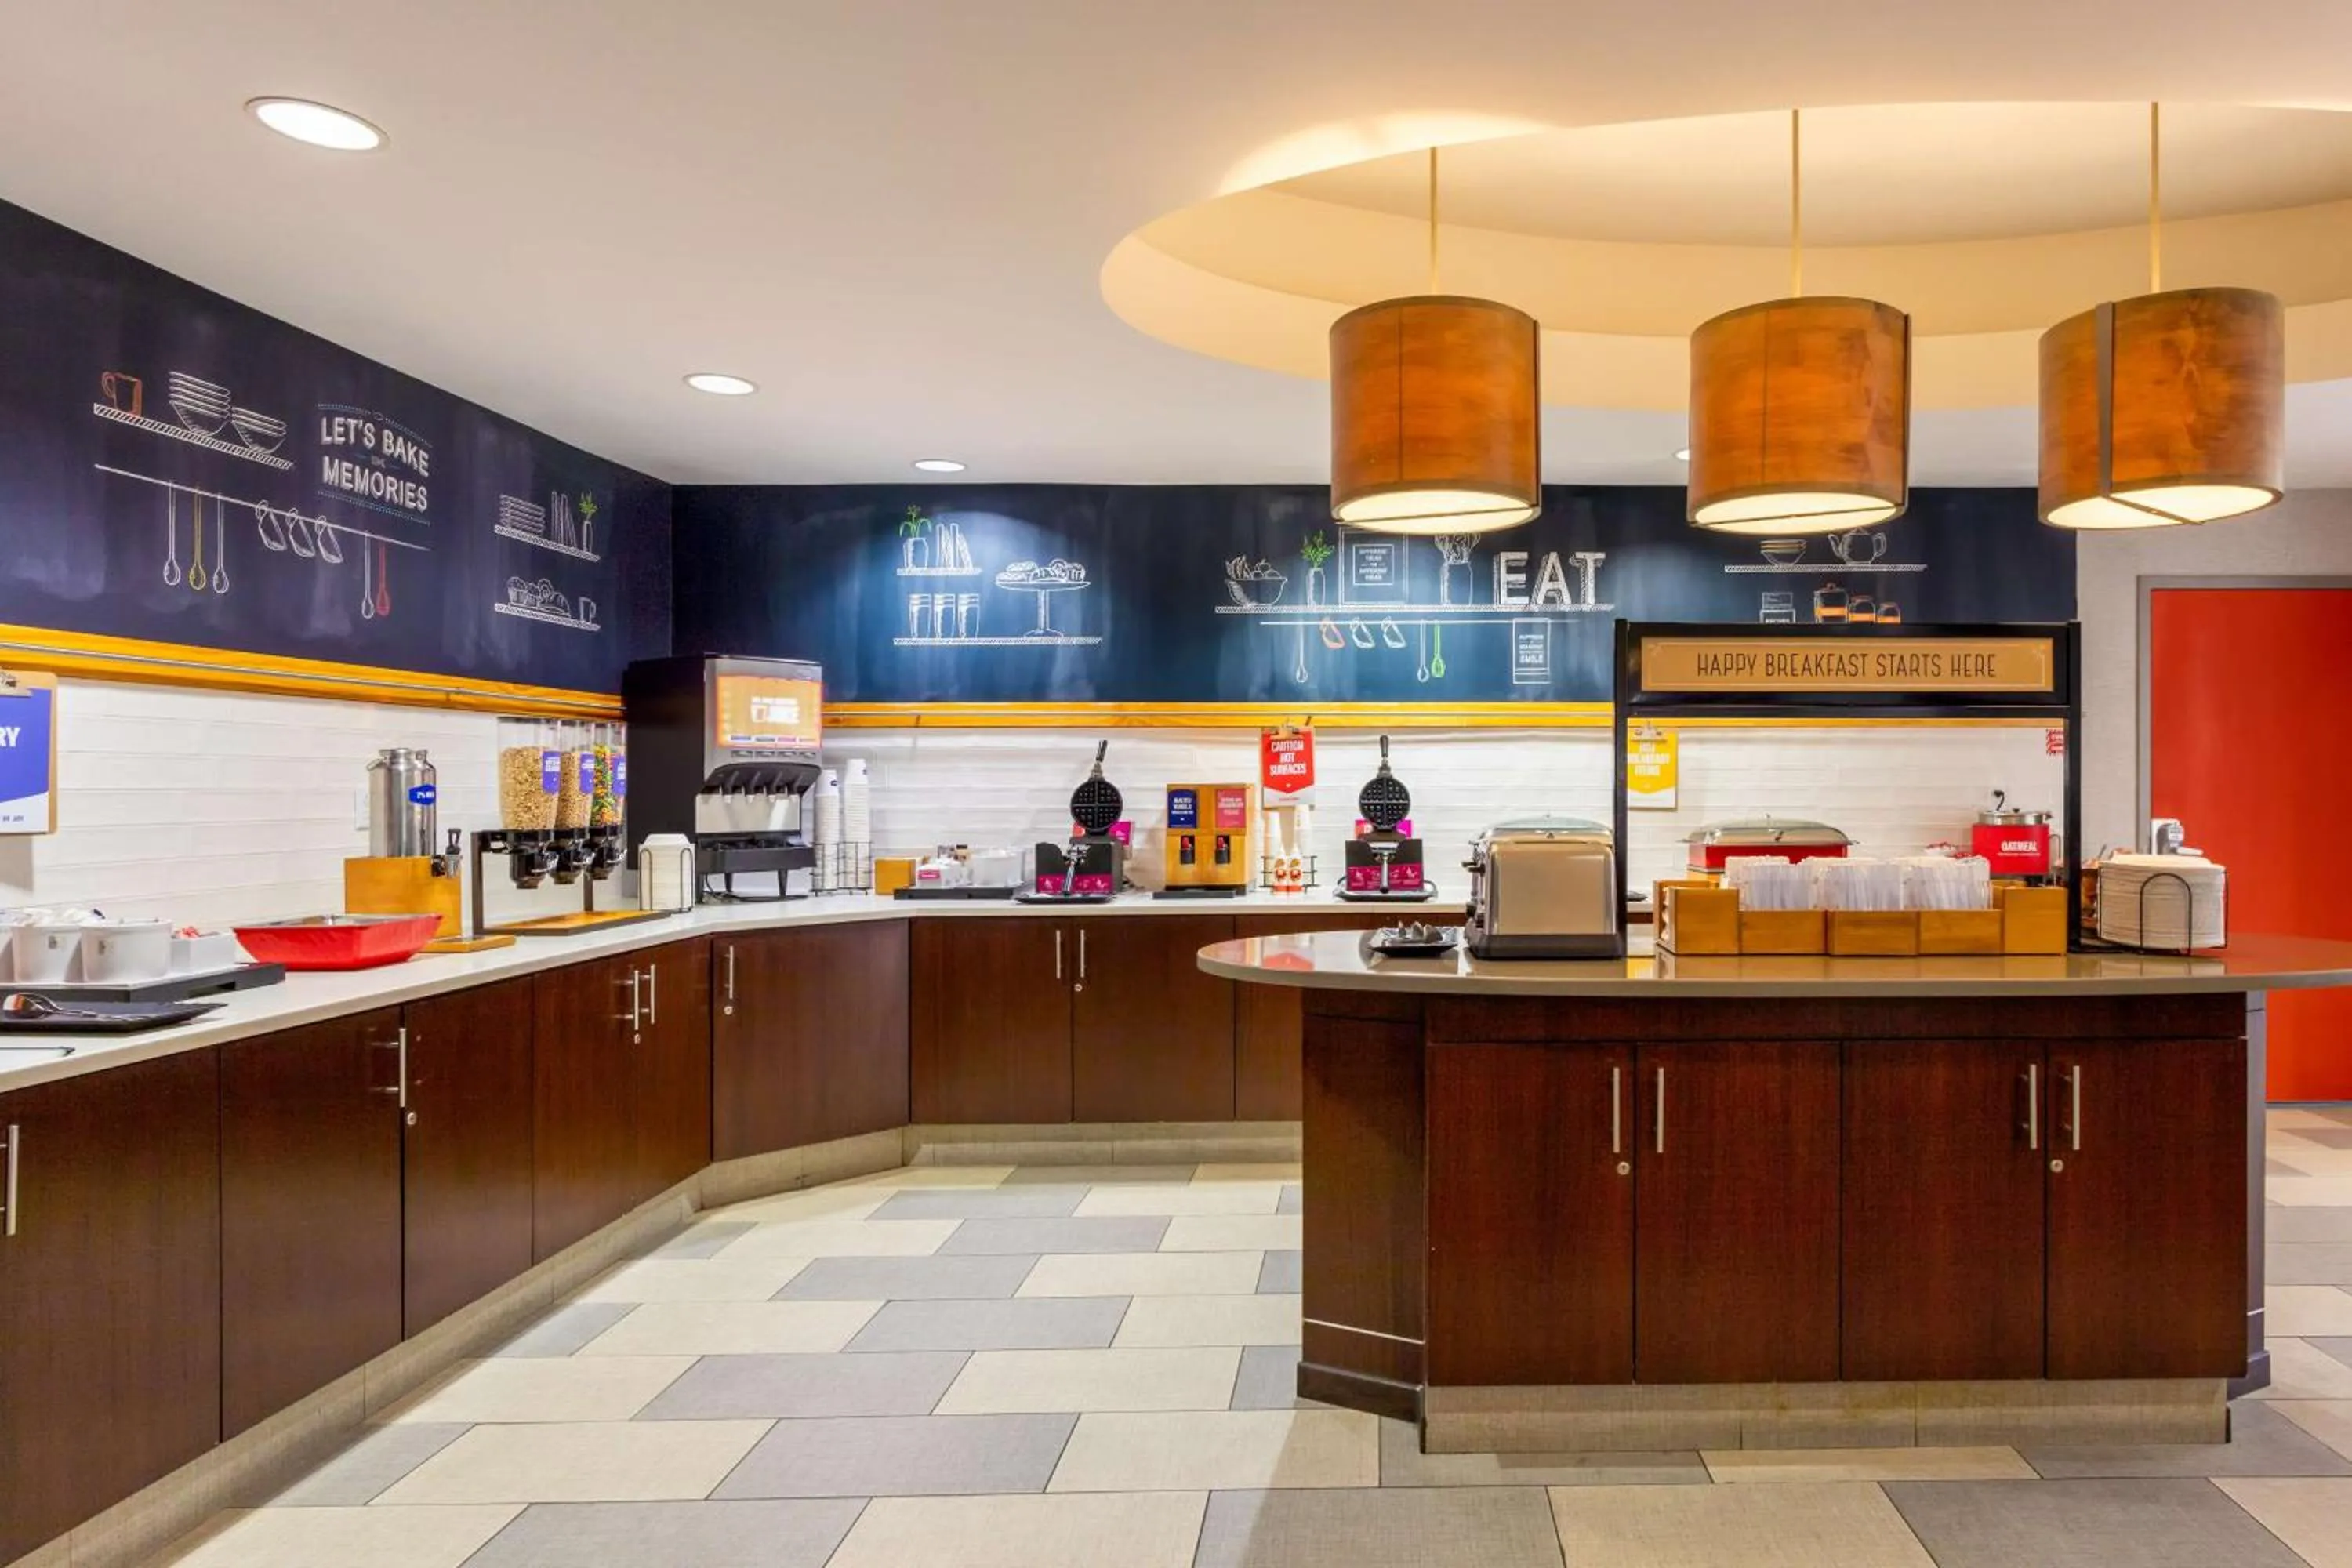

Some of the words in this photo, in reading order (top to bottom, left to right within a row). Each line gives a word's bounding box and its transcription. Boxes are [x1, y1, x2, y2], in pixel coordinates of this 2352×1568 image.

[321, 416, 376, 449] LET'S
[382, 429, 430, 478] BAKE
[322, 455, 428, 514] MEMORIES
[1493, 551, 1606, 606] EAT
[1697, 652, 1758, 677] HAPPY
[1765, 652, 1869, 677] BREAKFAST
[1875, 652, 1943, 678] STARTS
[1951, 653, 1998, 678] HERE
[1271, 739, 1305, 753] CAUTION
[1279, 752, 1296, 764] HOT
[1269, 763, 1308, 776] SURFACES
[2001, 840, 2038, 852] OATMEAL
